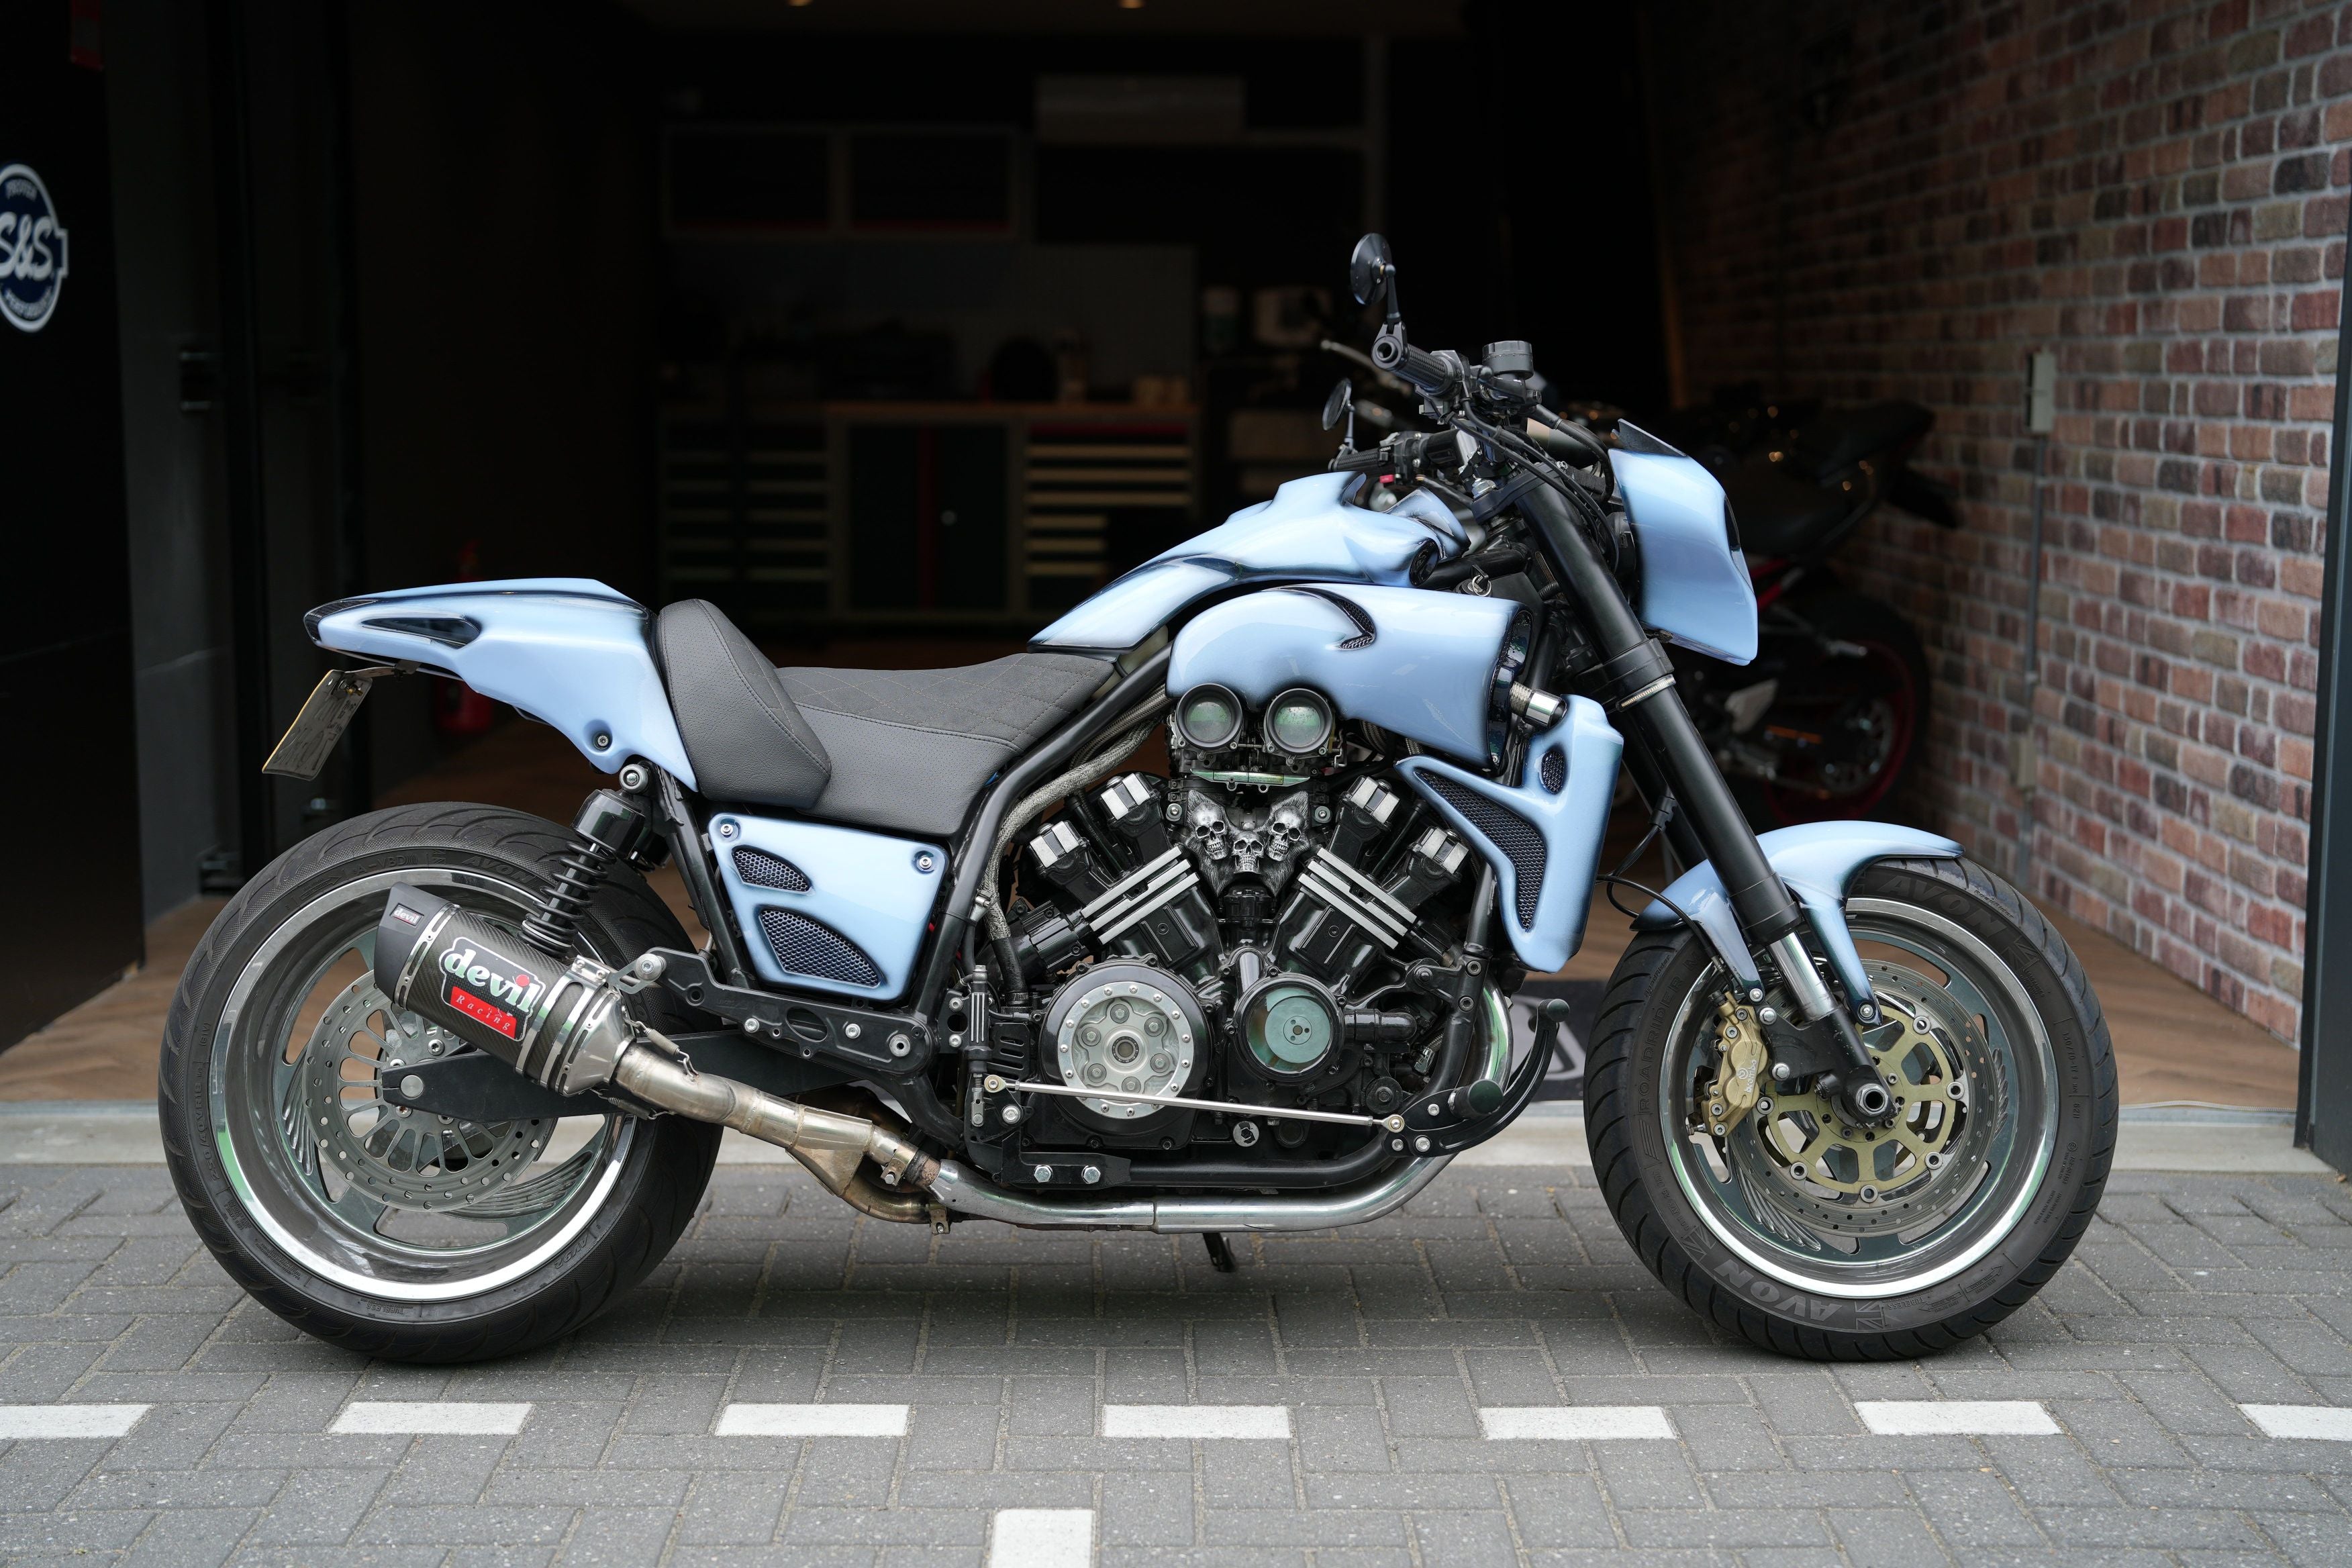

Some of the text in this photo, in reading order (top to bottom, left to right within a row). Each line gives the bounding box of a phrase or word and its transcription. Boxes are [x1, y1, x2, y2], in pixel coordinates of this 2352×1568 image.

[0, 211, 54, 281] S&S
[462, 855, 536, 884] AVON
[394, 908, 420, 924] devil
[1877, 875, 2008, 938] AVON
[444, 948, 541, 1013] devil
[456, 994, 511, 1031] Racing
[1638, 975, 1683, 1114] ROADRIDER
[1745, 1059, 1757, 1093] brembo
[1714, 1259, 1843, 1322] AVON
